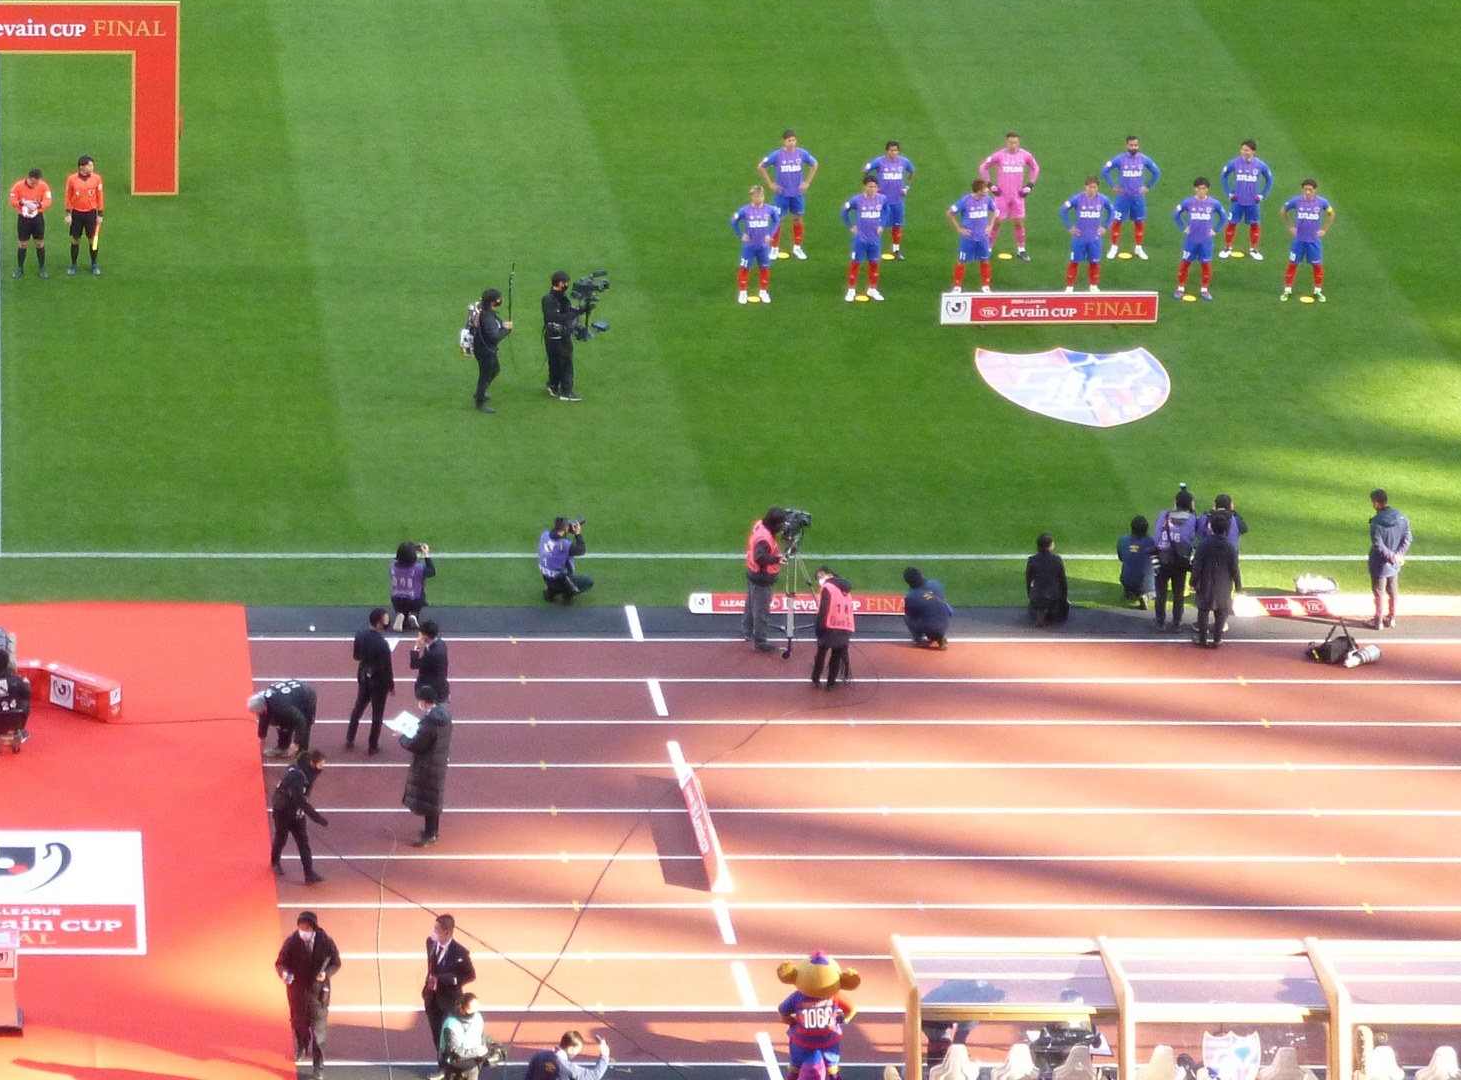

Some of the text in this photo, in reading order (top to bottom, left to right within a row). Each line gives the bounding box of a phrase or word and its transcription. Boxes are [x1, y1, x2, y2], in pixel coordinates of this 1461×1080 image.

[50, 23, 86, 37] CUP
[93, 20, 166, 37] FINAL
[1001, 305, 1050, 319] Levain
[1052, 308, 1078, 319] CUP
[1083, 302, 1147, 317] FINAL
[866, 598, 905, 611] FINA
[60, 919, 122, 932] CUP
